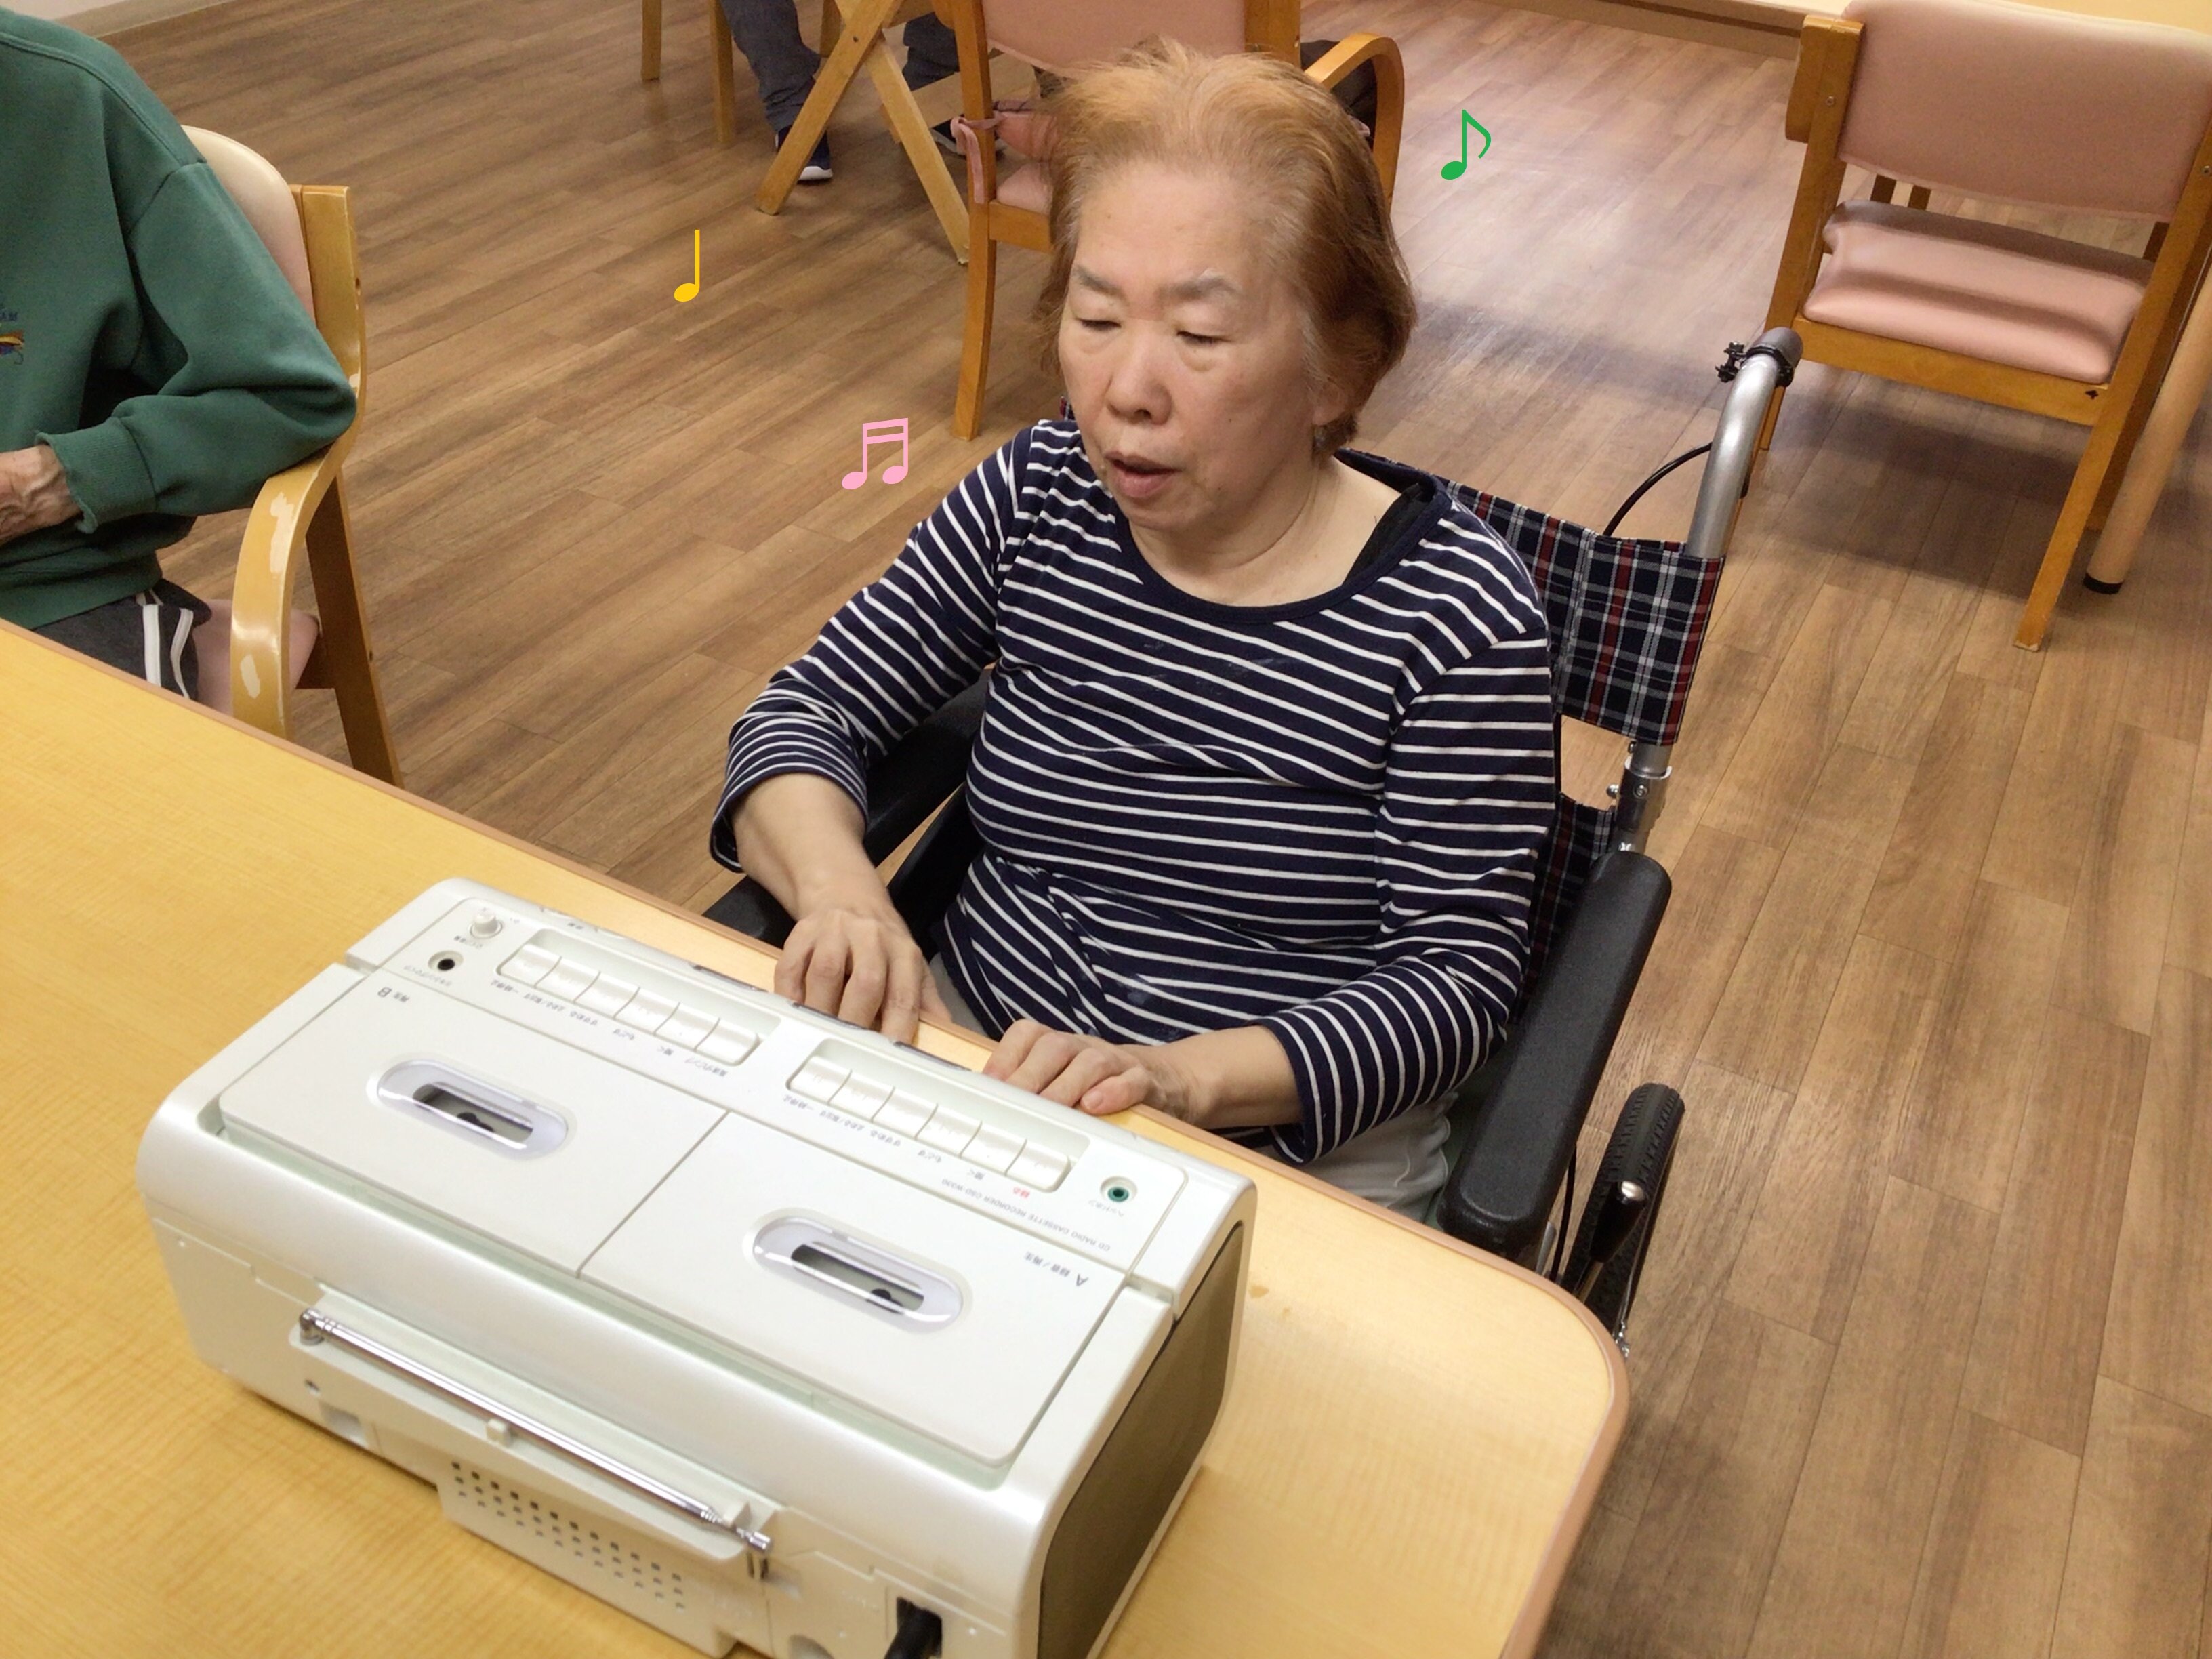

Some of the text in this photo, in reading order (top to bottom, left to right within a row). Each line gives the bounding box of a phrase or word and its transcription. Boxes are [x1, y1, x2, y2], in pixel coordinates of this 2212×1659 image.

[377, 987, 392, 998] B
[983, 1195, 1027, 1217] RECORDER
[1028, 1213, 1069, 1235] CASSETTE
[1071, 1231, 1097, 1246] RADIO
[1097, 1242, 1111, 1252] CD
[1076, 1273, 1089, 1287] A
